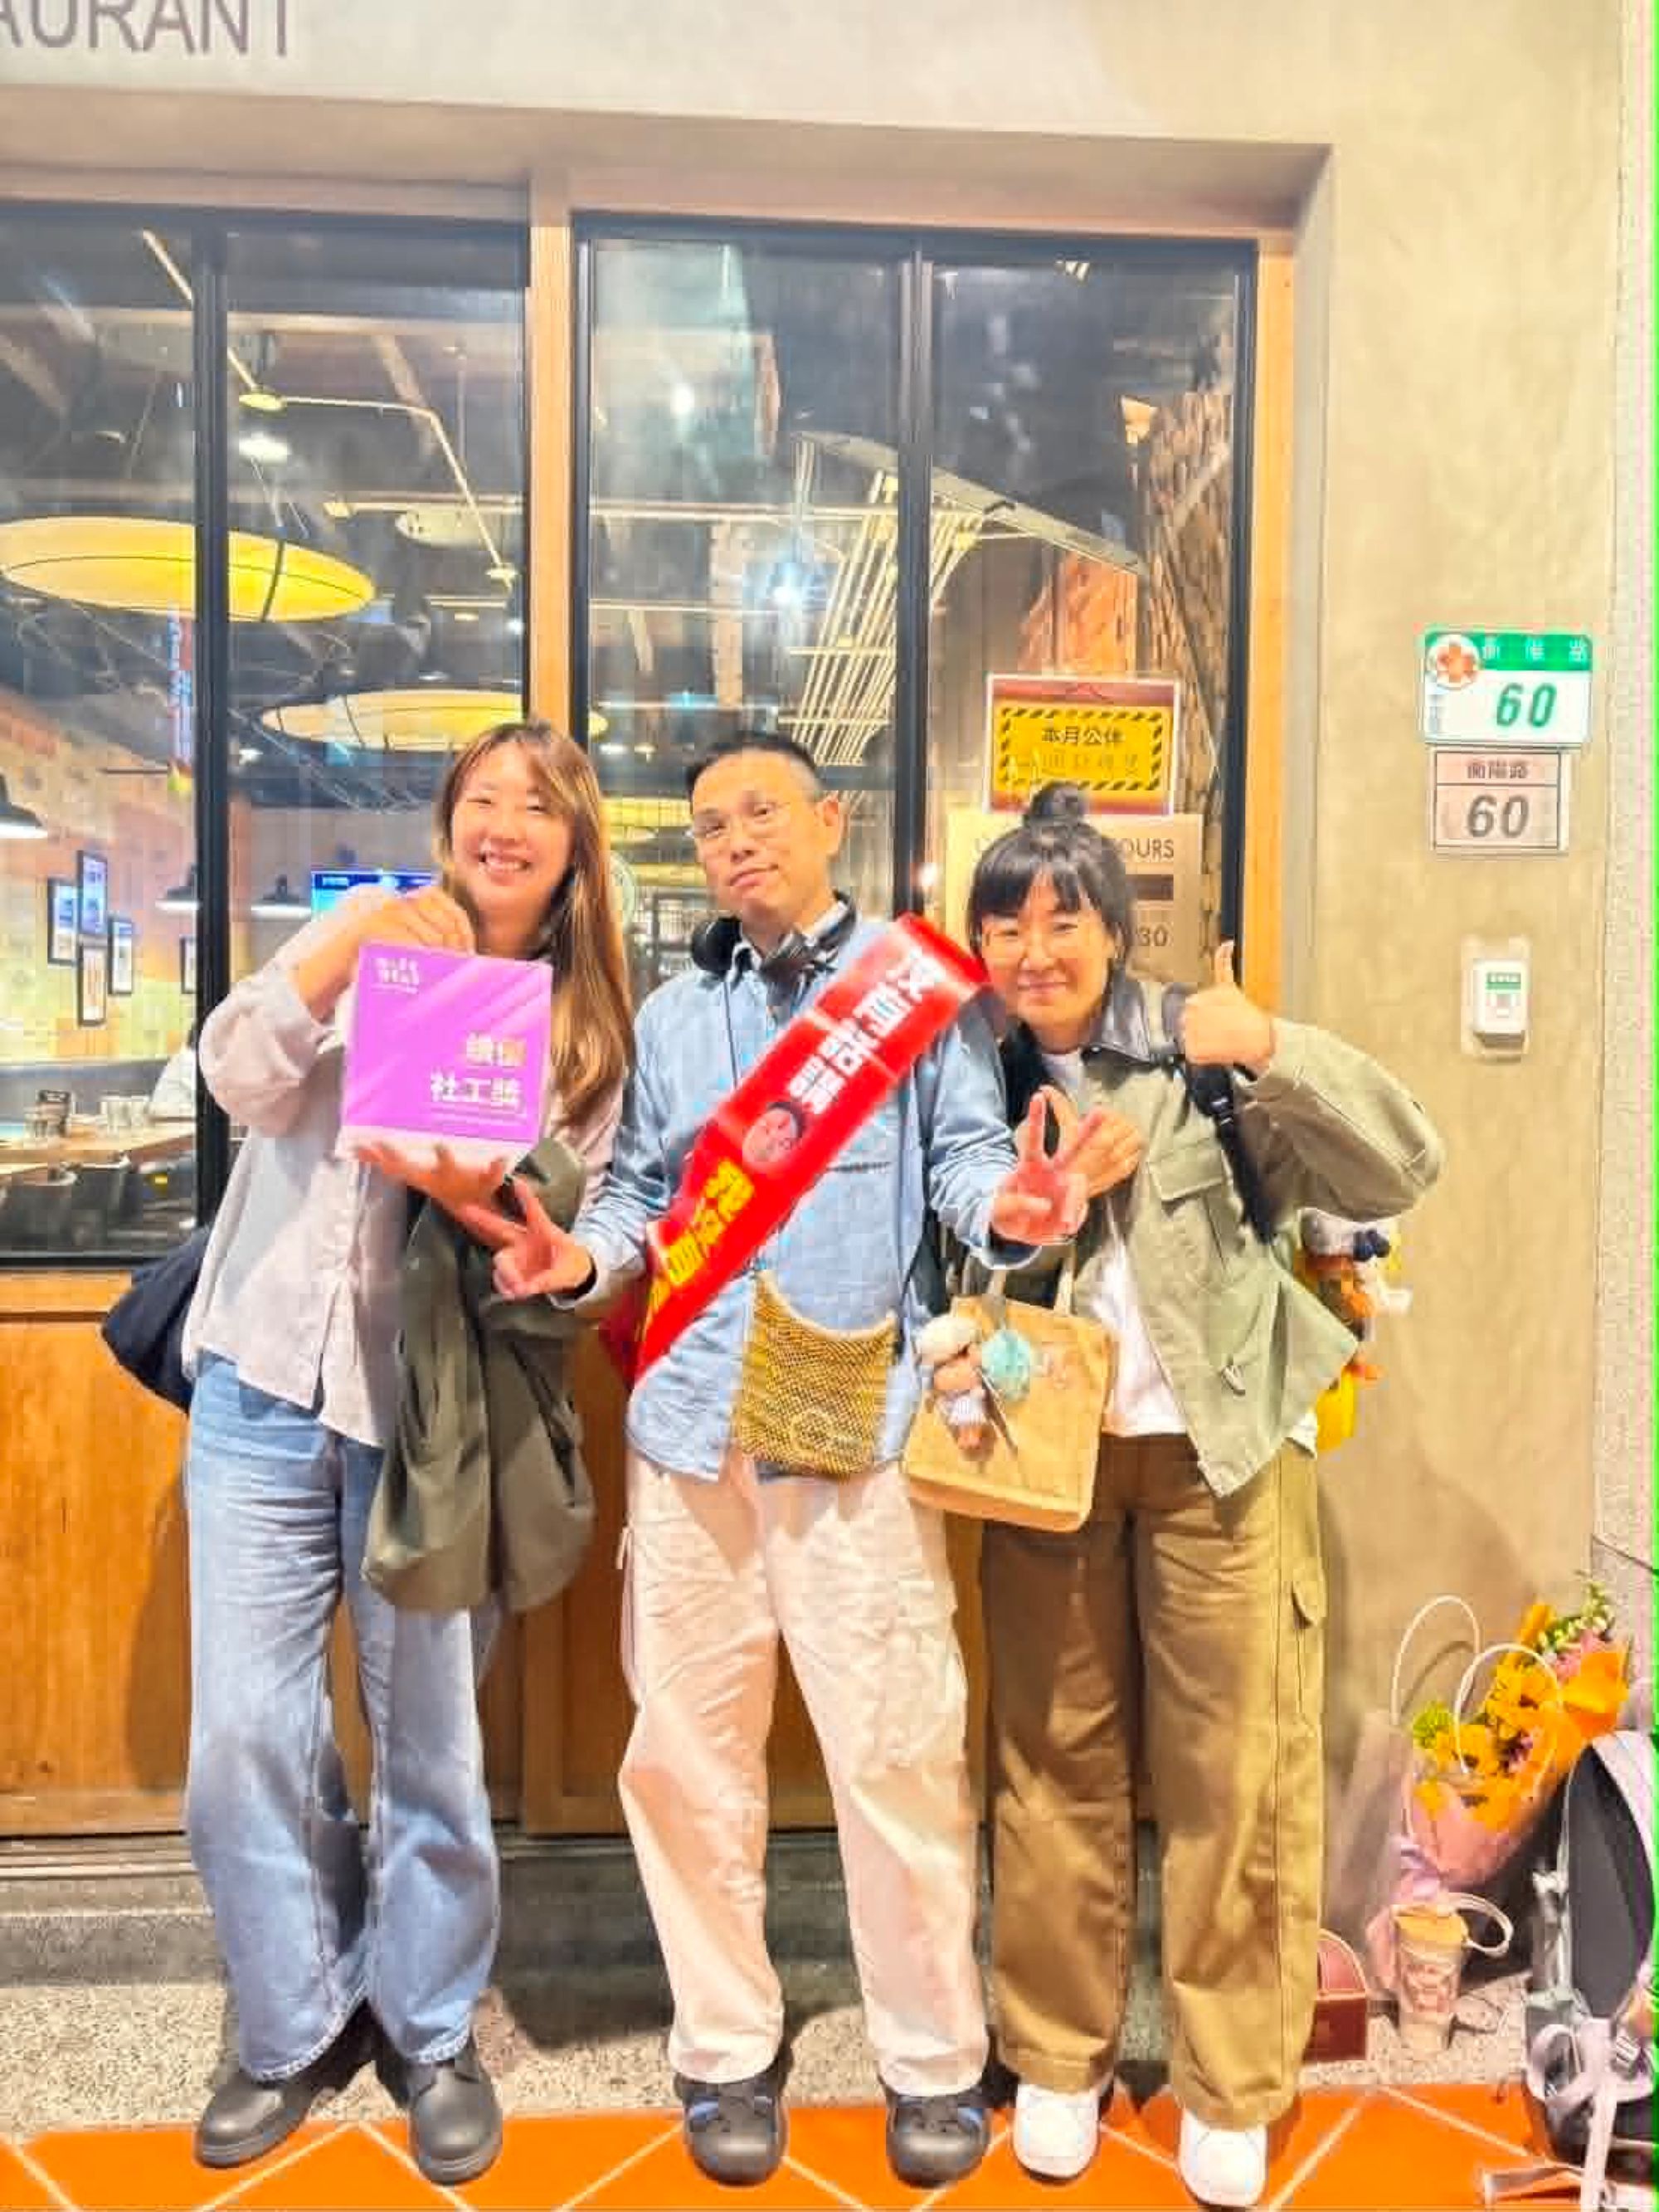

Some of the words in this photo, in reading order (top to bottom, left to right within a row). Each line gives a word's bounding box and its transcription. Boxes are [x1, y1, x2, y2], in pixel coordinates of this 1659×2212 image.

[1496, 682, 1557, 728] 60
[1467, 794, 1530, 838] 60
[1121, 838, 1175, 859] OURS
